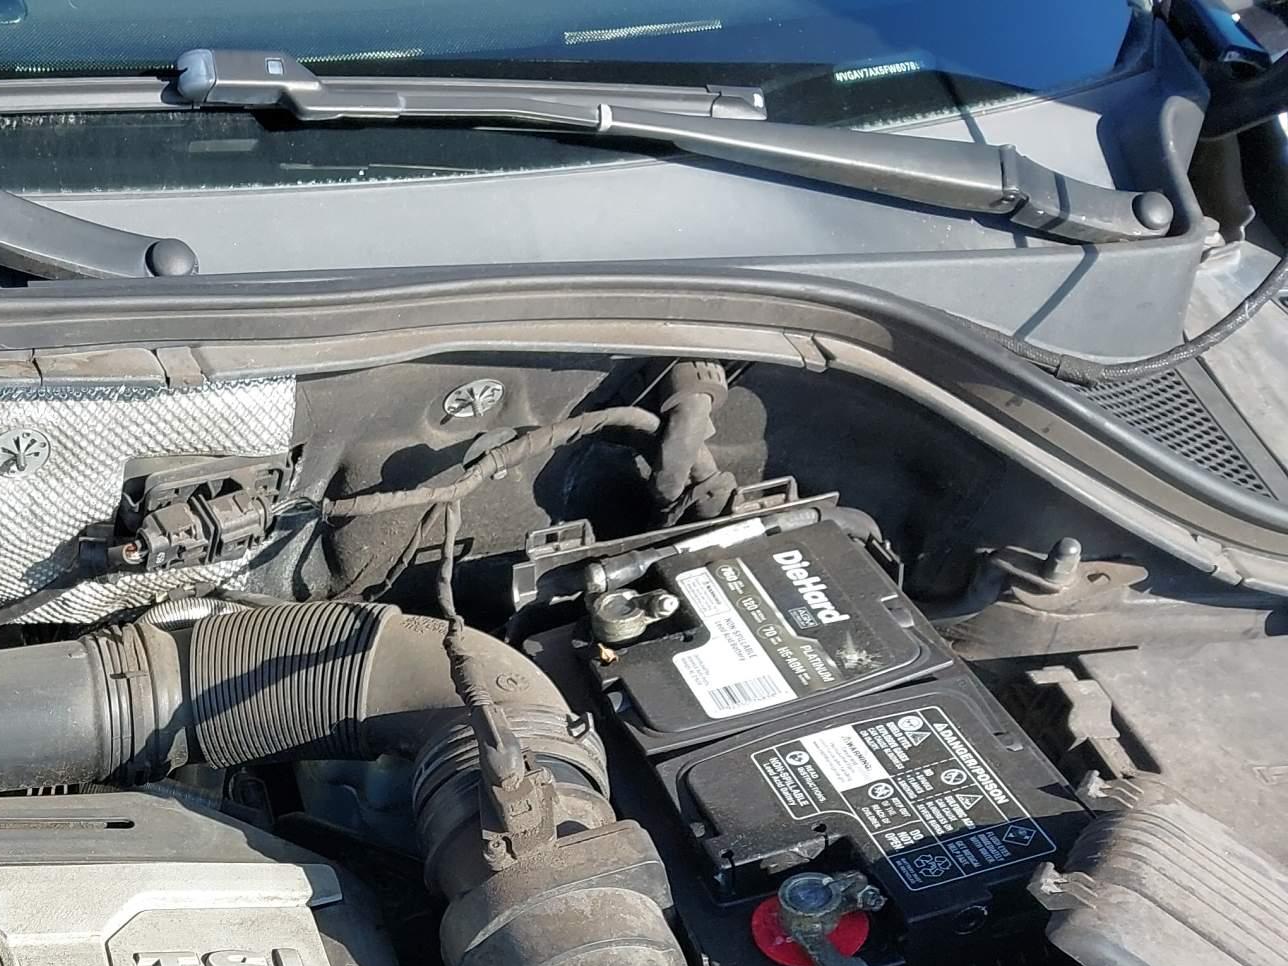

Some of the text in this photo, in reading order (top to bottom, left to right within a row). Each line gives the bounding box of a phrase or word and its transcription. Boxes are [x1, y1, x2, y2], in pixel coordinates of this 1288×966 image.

[773, 550, 851, 624] DieHard
[741, 597, 759, 611] 120
[797, 607, 818, 627] AGM
[762, 625, 778, 638] 70
[799, 644, 835, 682] PLATINUM
[859, 730, 870, 738] OR
[875, 724, 899, 749] EXPLOSIVE
[867, 727, 905, 770] CAN CAUSE BLINDNESS
[804, 764, 819, 779] READ
[922, 768, 935, 777] NO
[939, 728, 1009, 805] DANGER/POISON
[762, 762, 801, 806] Lead Acid Battery
[768, 757, 810, 807] NON-SPILLABLE
[871, 803, 886, 819] REACH
[880, 799, 897, 817] OF THE
[890, 797, 912, 817] KEEP OUT
[916, 803, 934, 820] SEVERE
[925, 801, 954, 832] BLINDNESS OR
[934, 798, 958, 822] CAN CAUSE
[896, 831, 915, 845] NOT
[909, 828, 924, 841] DO
